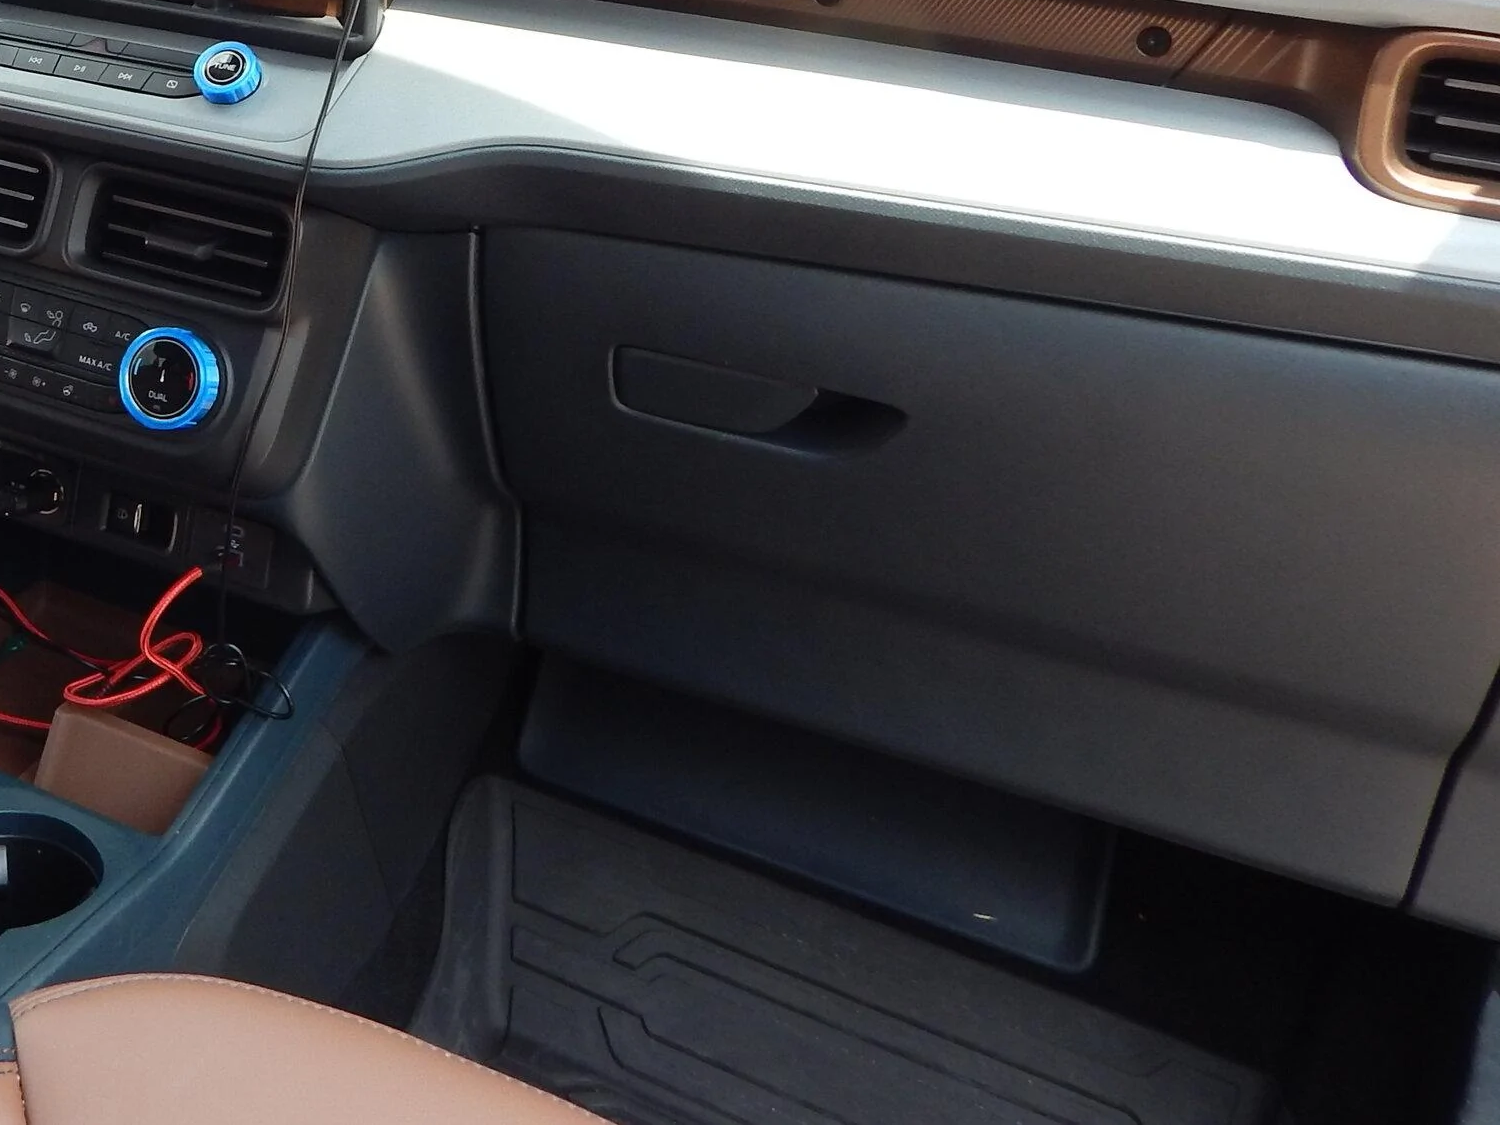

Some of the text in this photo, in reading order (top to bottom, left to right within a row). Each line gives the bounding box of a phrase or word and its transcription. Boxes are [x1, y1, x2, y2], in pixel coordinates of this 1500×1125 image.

[213, 62, 237, 72] TUNE
[115, 330, 131, 342] A/C
[78, 355, 113, 372] MAX A/C
[148, 390, 168, 403] DUAL
